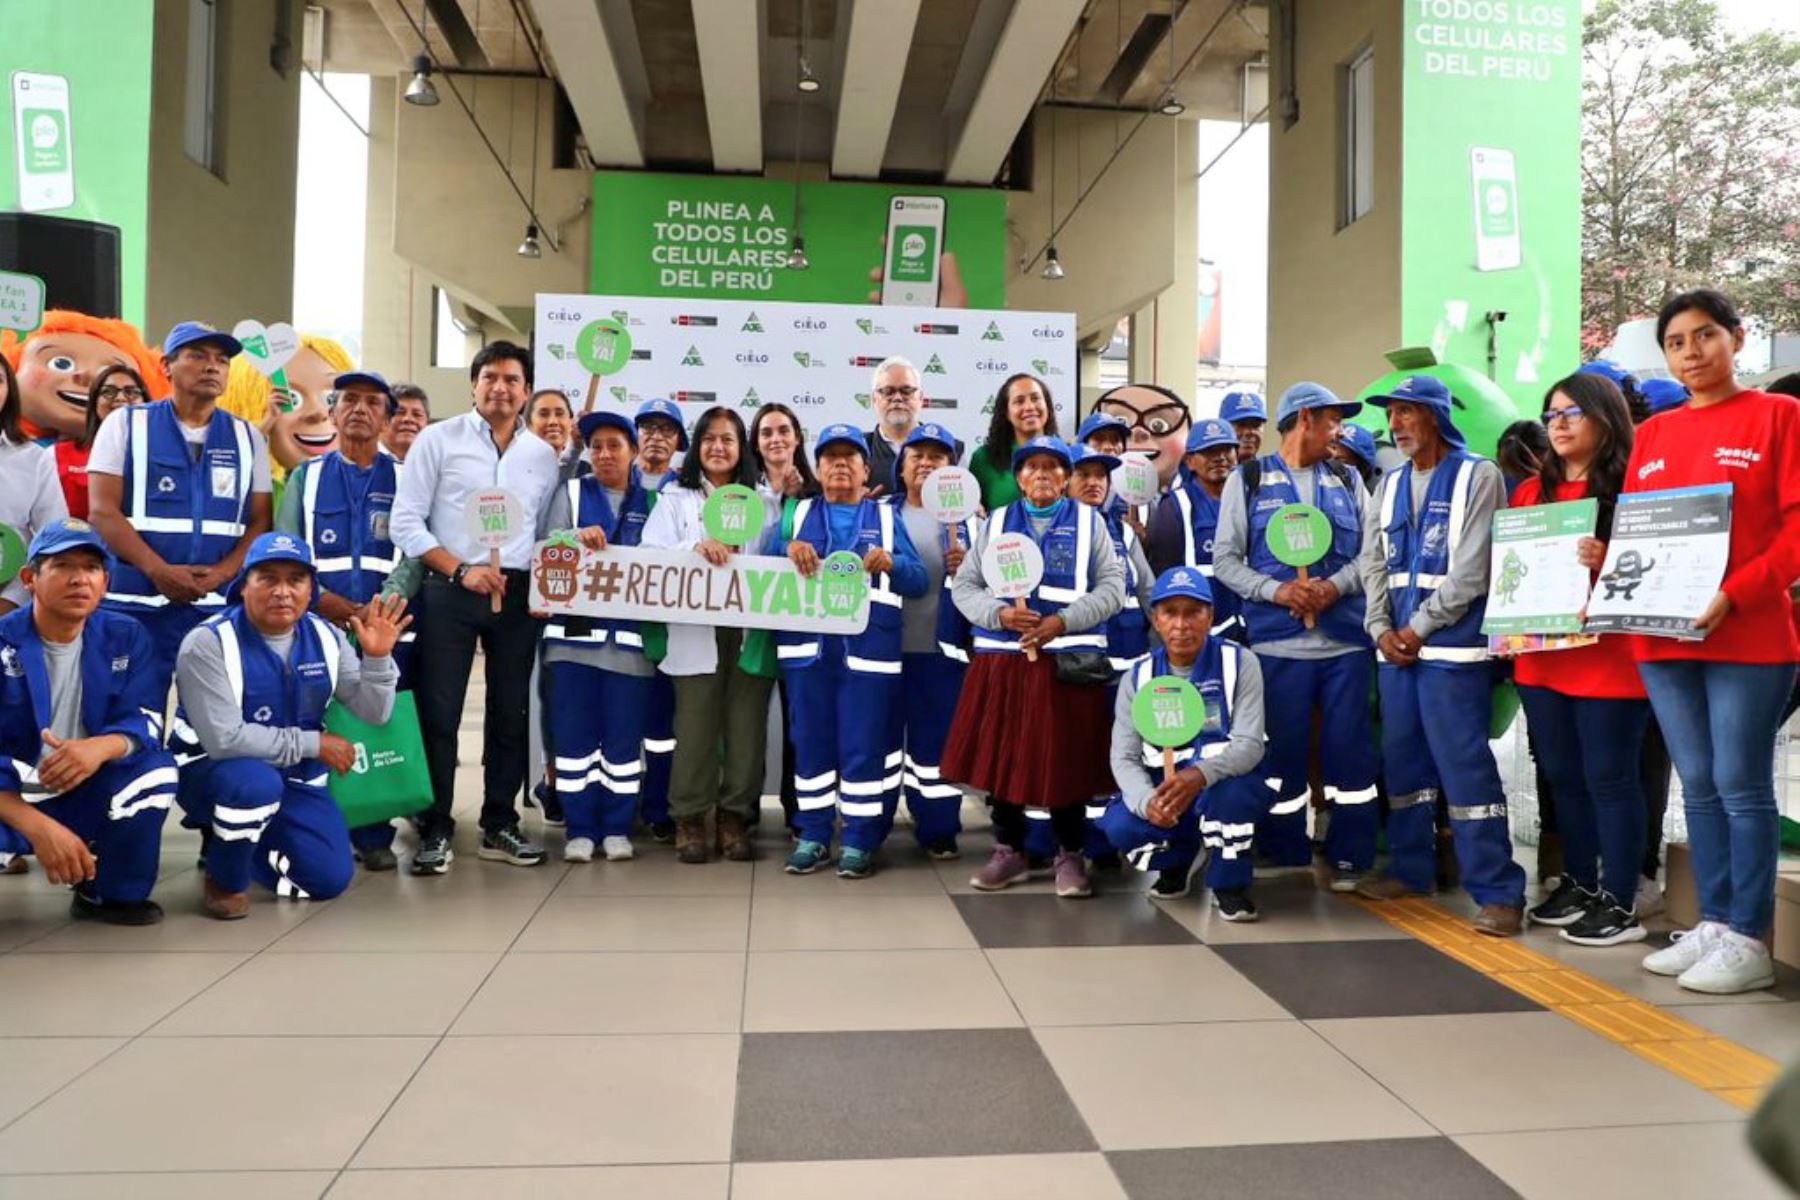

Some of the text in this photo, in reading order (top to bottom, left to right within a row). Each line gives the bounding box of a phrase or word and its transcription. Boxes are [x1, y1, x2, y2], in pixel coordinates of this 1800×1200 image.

[1420, 0, 1566, 28] TODOS LOS
[1415, 23, 1568, 55] CELULARES
[1425, 51, 1551, 81] DEL PERÚ
[668, 200, 775, 222] PLINEA A
[653, 222, 788, 245] TODOS LOS
[652, 245, 788, 268] CELULARES
[660, 267, 773, 290] DEL PERÚ
[548, 310, 582, 321] CIELO
[794, 318, 827, 330] CIELO
[1032, 326, 1064, 338] CIELO
[735, 353, 769, 363] CIELO
[976, 360, 1008, 371] CIELO
[793, 394, 826, 405] CIELO
[1714, 446, 1760, 461] Jesús
[939, 491, 964, 508] YA!
[481, 514, 508, 532] YA!
[720, 513, 746, 531] YA!
[999, 562, 1028, 581] YA!
[547, 579, 572, 595] YA!
[828, 593, 855, 609] YA!
[1152, 709, 1185, 729] YA!
